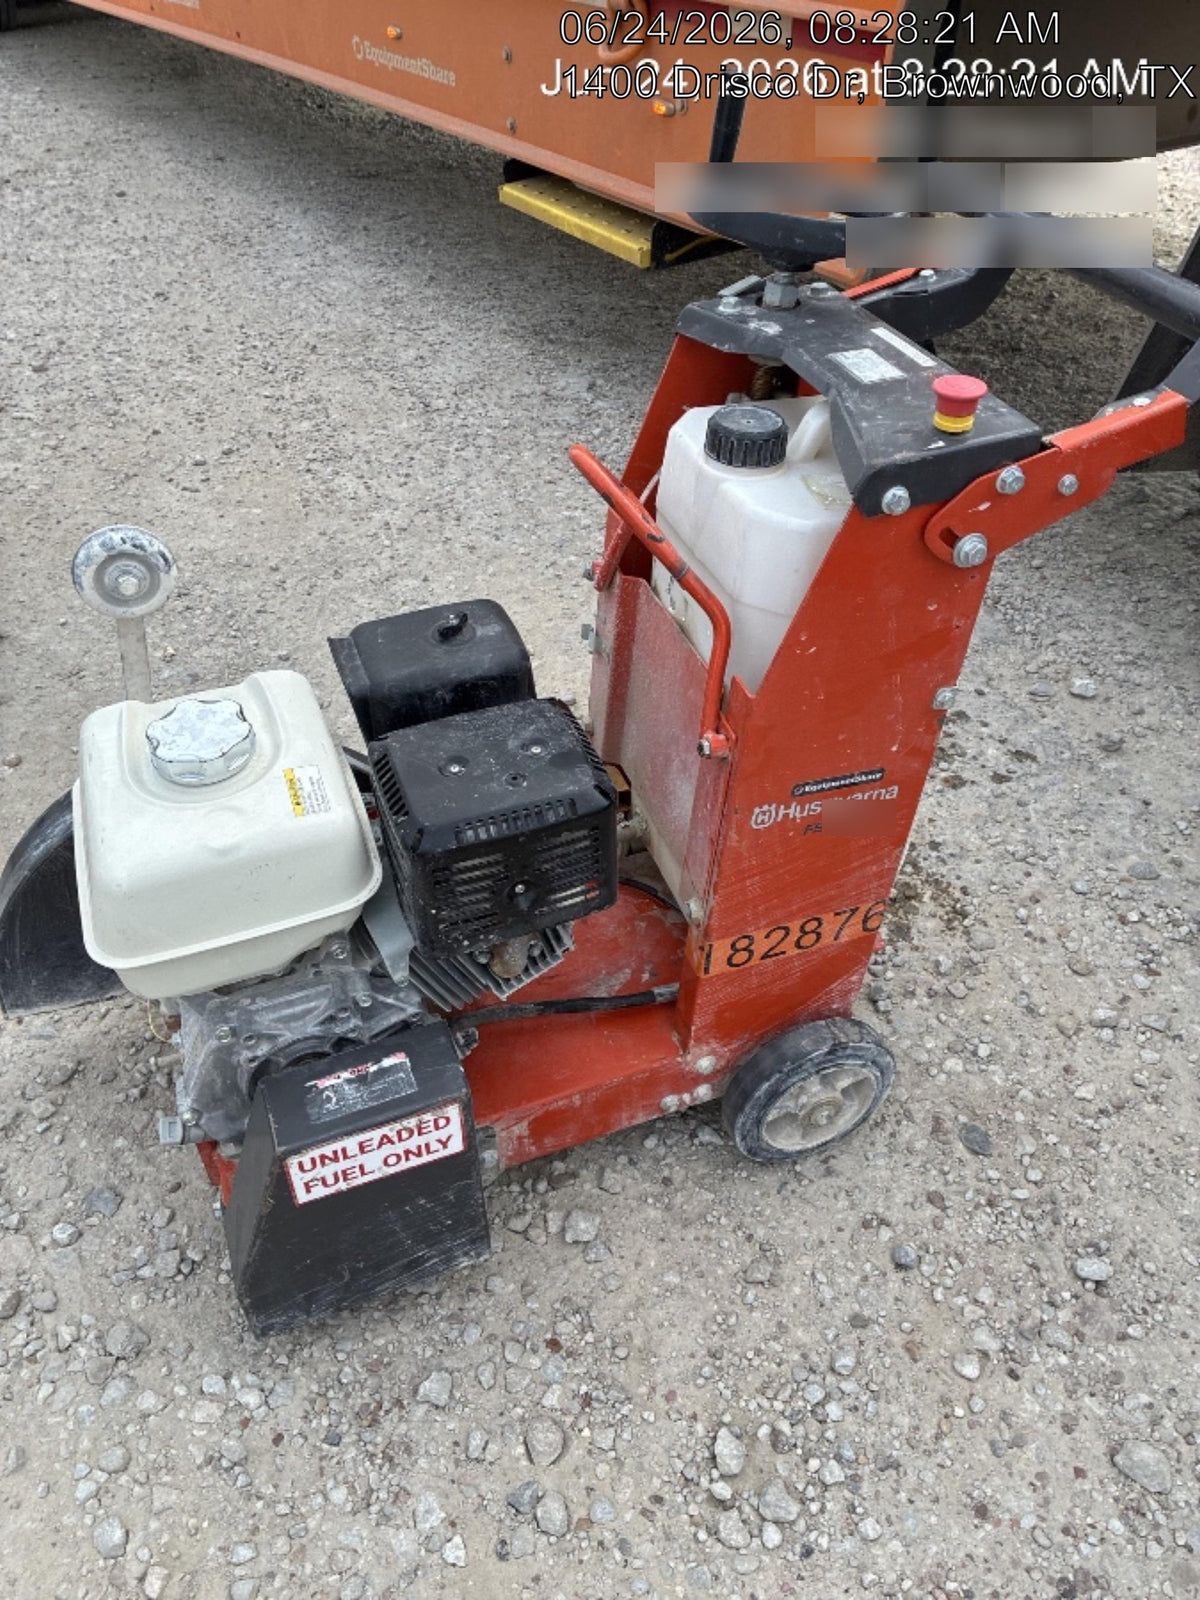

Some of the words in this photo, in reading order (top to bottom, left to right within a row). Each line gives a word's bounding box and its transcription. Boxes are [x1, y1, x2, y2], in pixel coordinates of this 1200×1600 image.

[699, 901, 887, 975] 182876
[297, 1116, 452, 1174] UNLEADED
[303, 1163, 375, 1194] FUEL
[383, 1134, 453, 1169] ONLY
